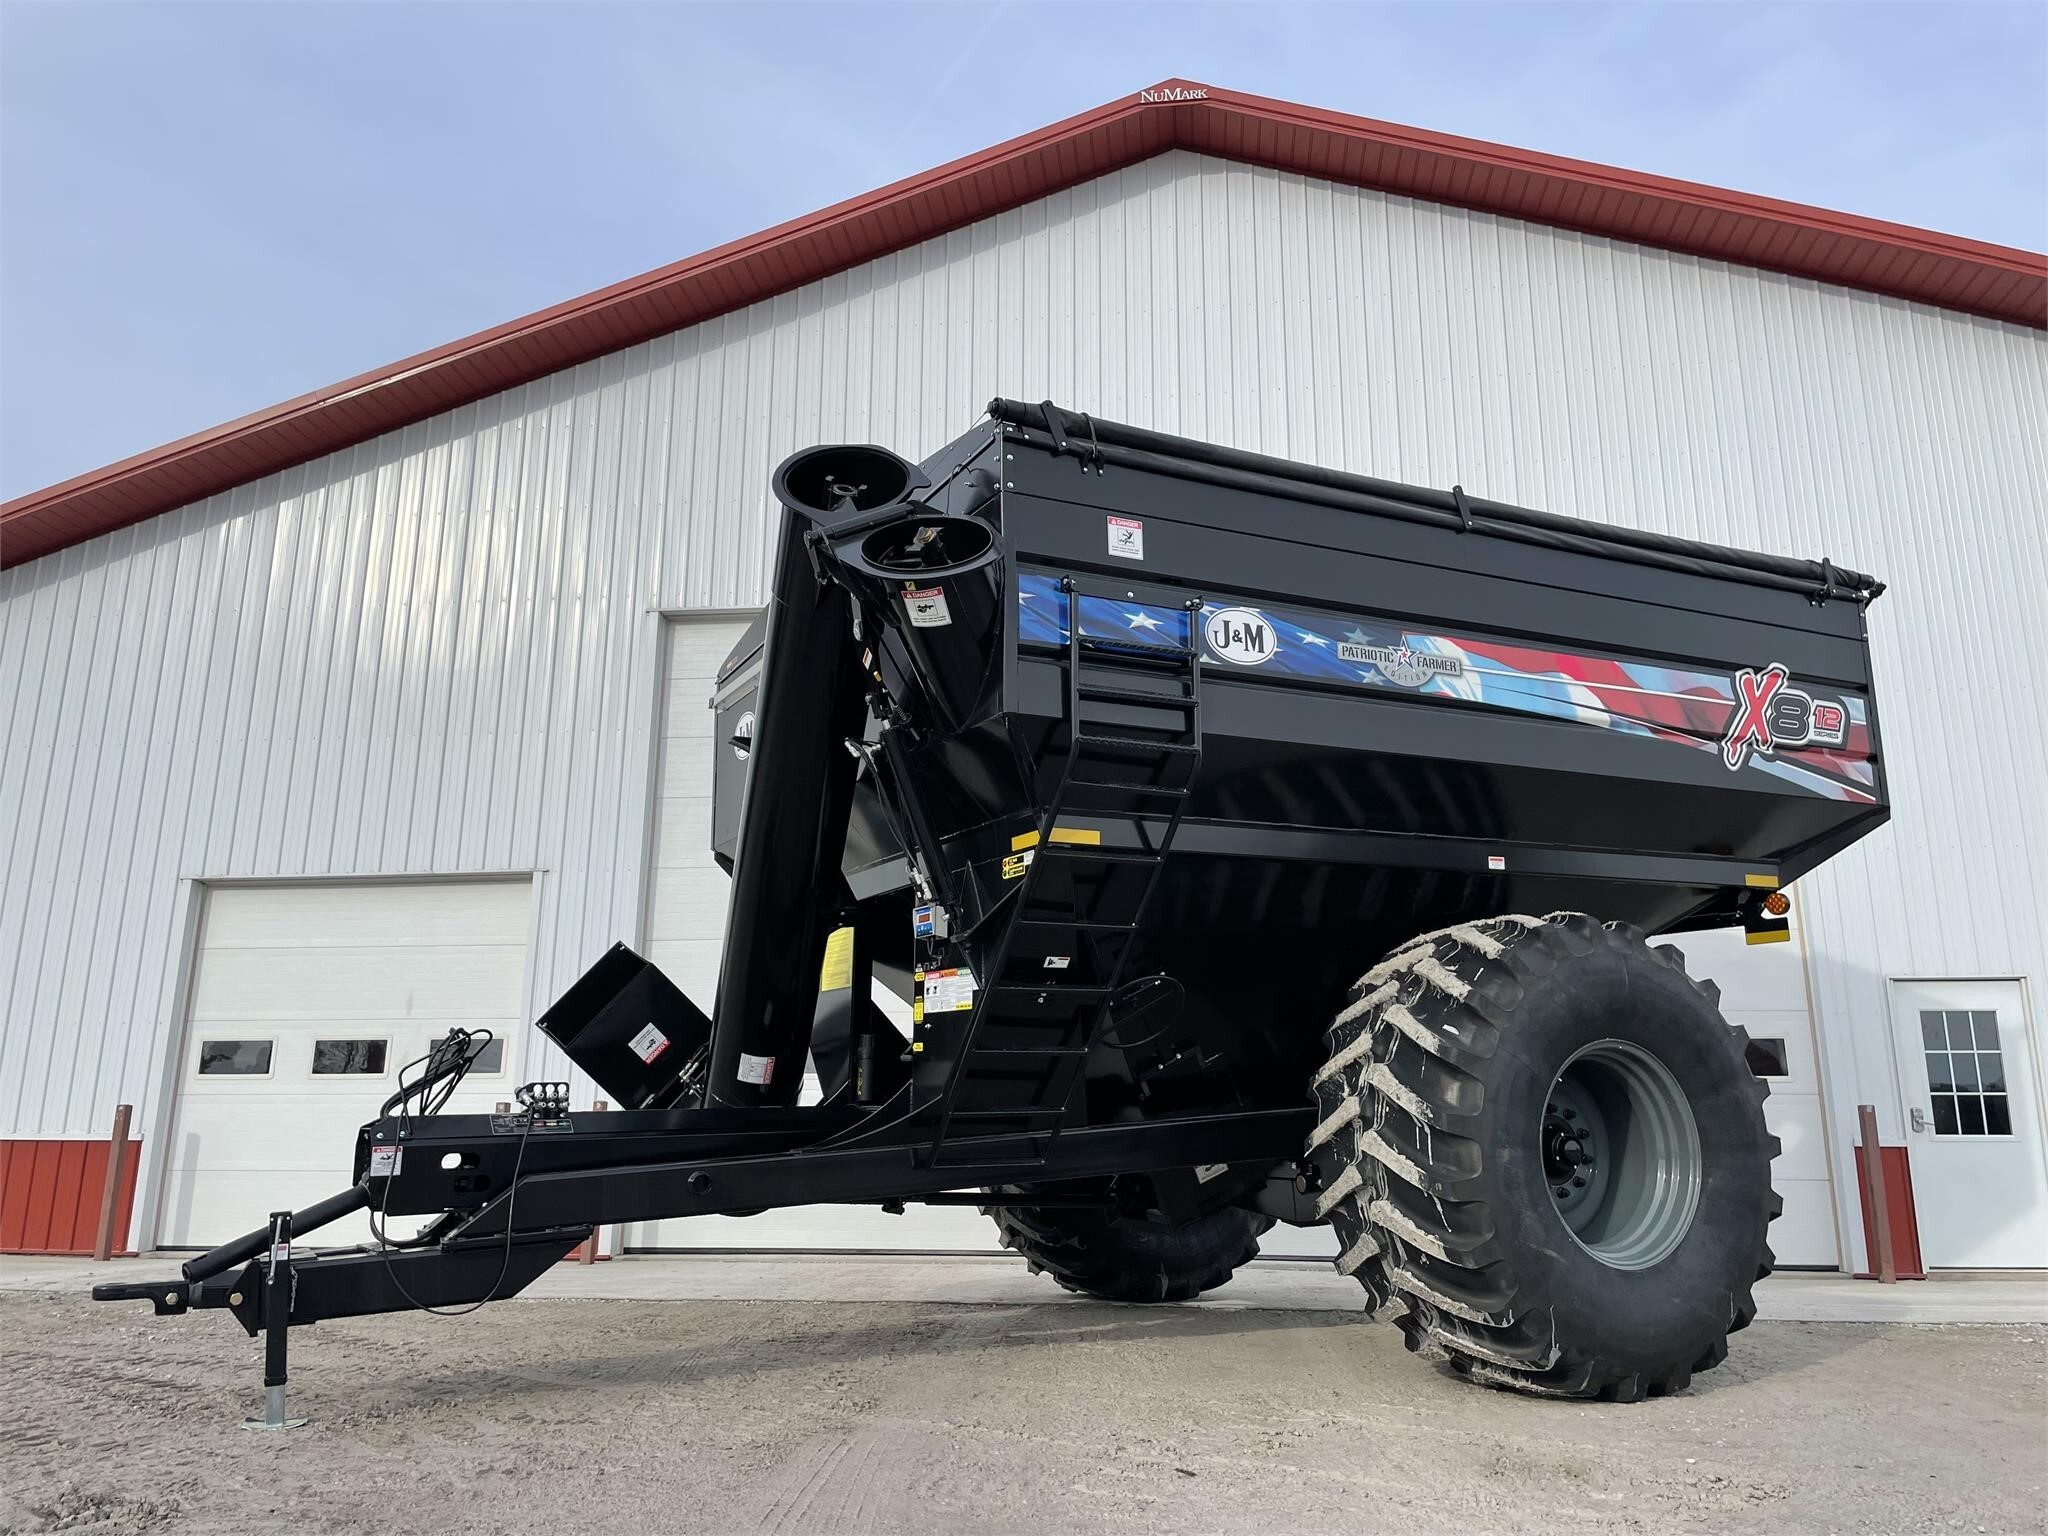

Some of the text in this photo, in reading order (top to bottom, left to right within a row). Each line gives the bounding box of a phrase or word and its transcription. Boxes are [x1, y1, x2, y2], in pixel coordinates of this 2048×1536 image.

[1118, 519, 1139, 528] DANGER
[912, 590, 939, 598] DANGER
[1213, 620, 1265, 654] J&M
[1341, 645, 1394, 664] PATRIOTIC
[1416, 656, 1457, 672] FARMER
